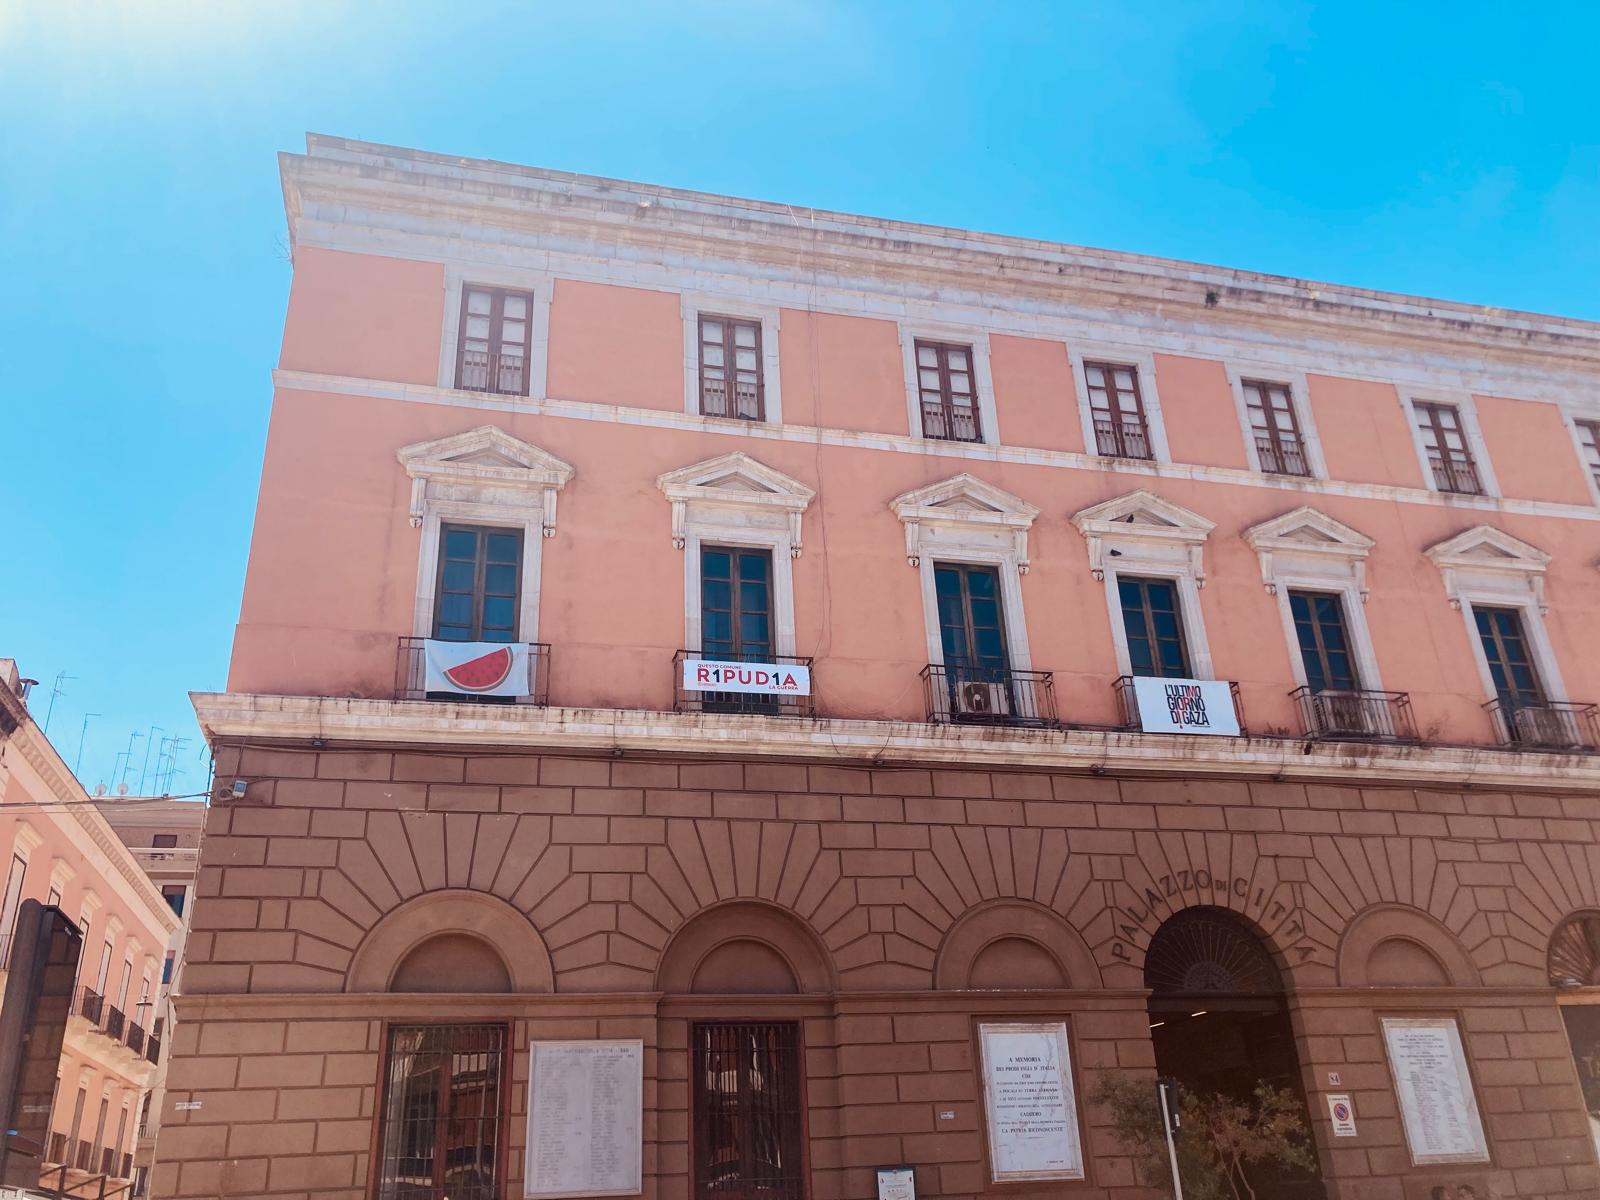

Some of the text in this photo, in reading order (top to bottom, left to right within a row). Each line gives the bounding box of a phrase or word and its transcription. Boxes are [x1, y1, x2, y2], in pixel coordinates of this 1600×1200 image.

[697, 668, 798, 687] R1PUD1A
[1164, 684, 1202, 698] L'ULTIMO
[1166, 696, 1206, 711] GIORNO
[1170, 711, 1210, 726] DI GAZA
[1111, 869, 1212, 962] PALAZZO
[1215, 879, 1227, 891] DI
